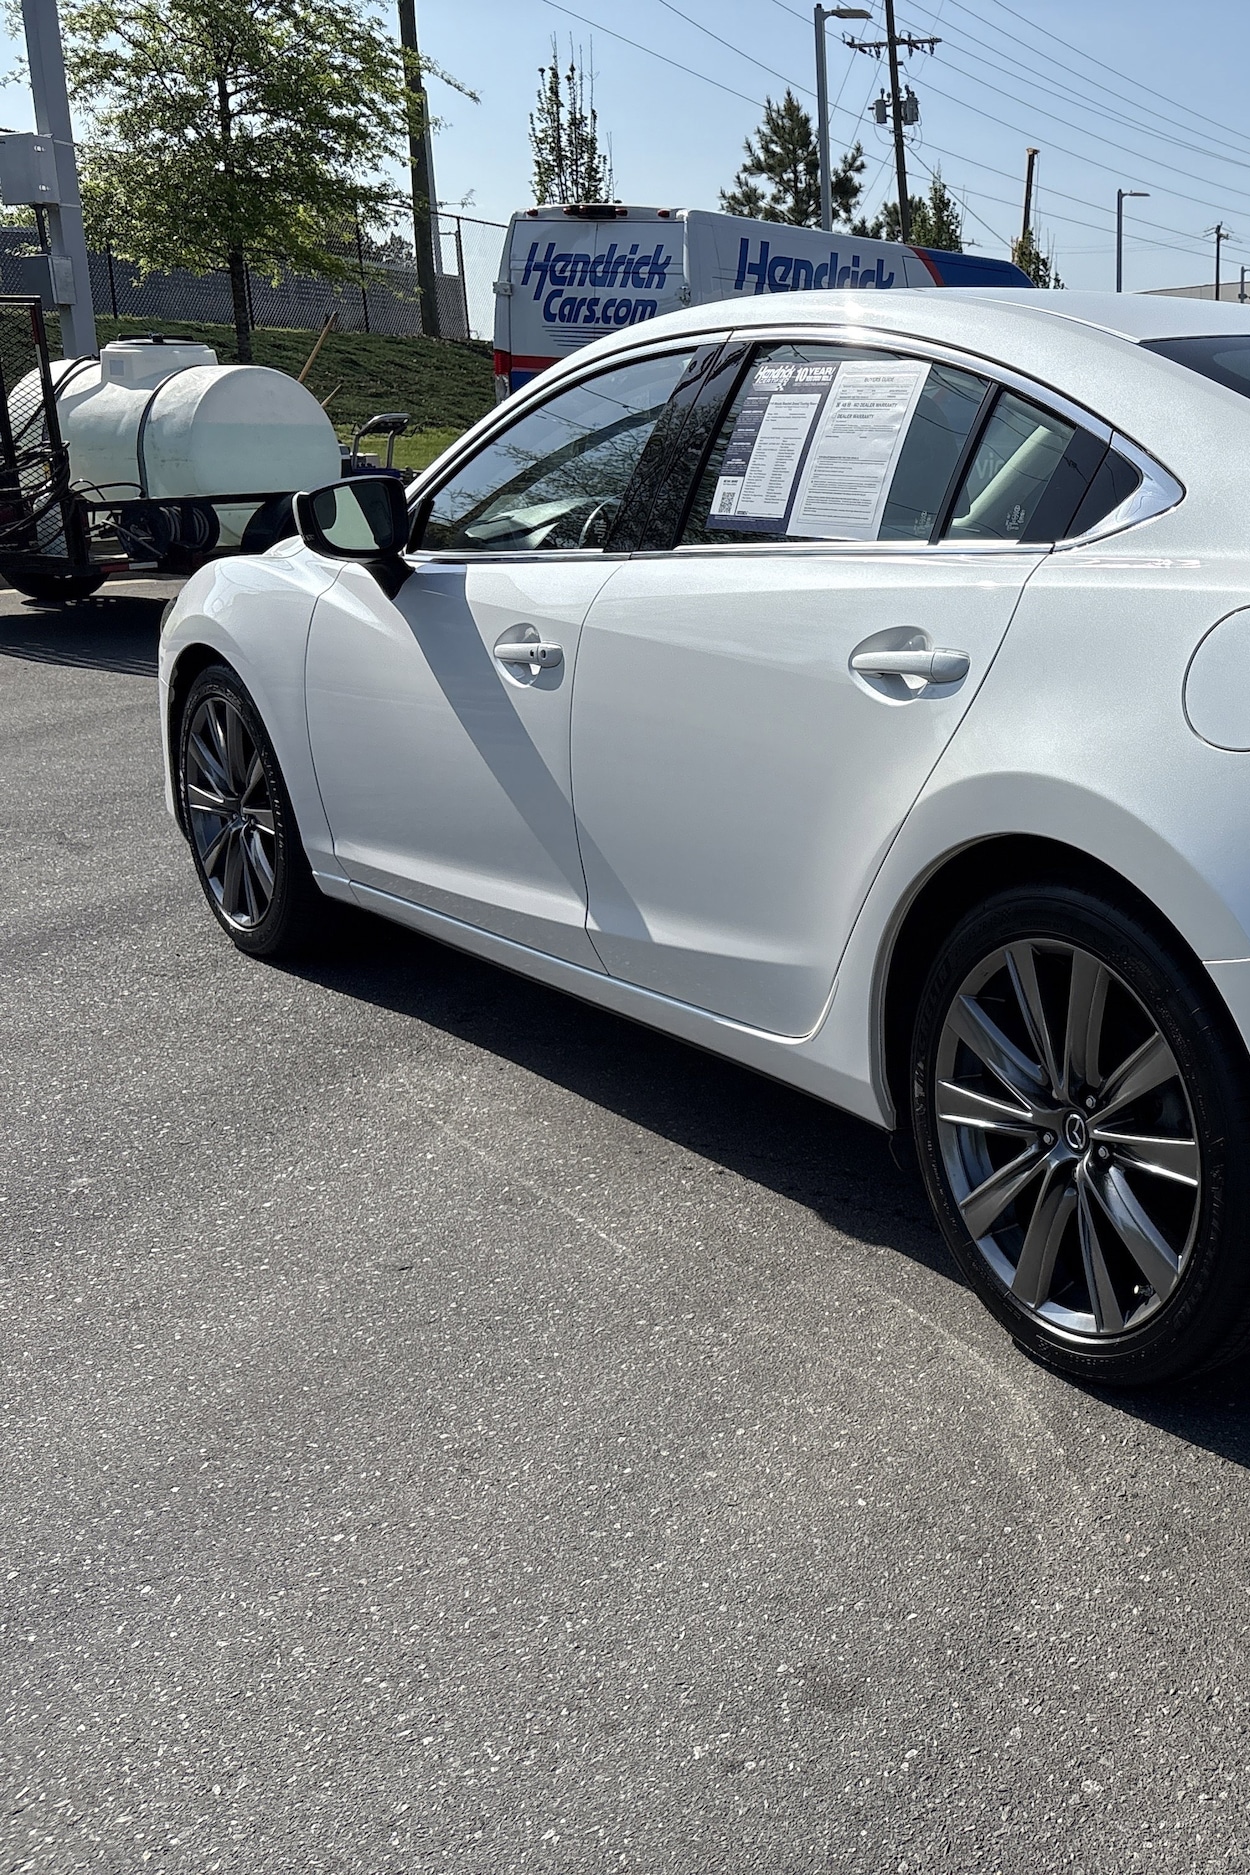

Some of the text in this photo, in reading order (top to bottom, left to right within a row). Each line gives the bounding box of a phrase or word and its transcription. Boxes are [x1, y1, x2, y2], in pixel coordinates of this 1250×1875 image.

[520, 242, 673, 301] Hendrick
[734, 237, 895, 295] Hendrick
[543, 288, 658, 325] Cars.com
[795, 367, 809, 382] 10
